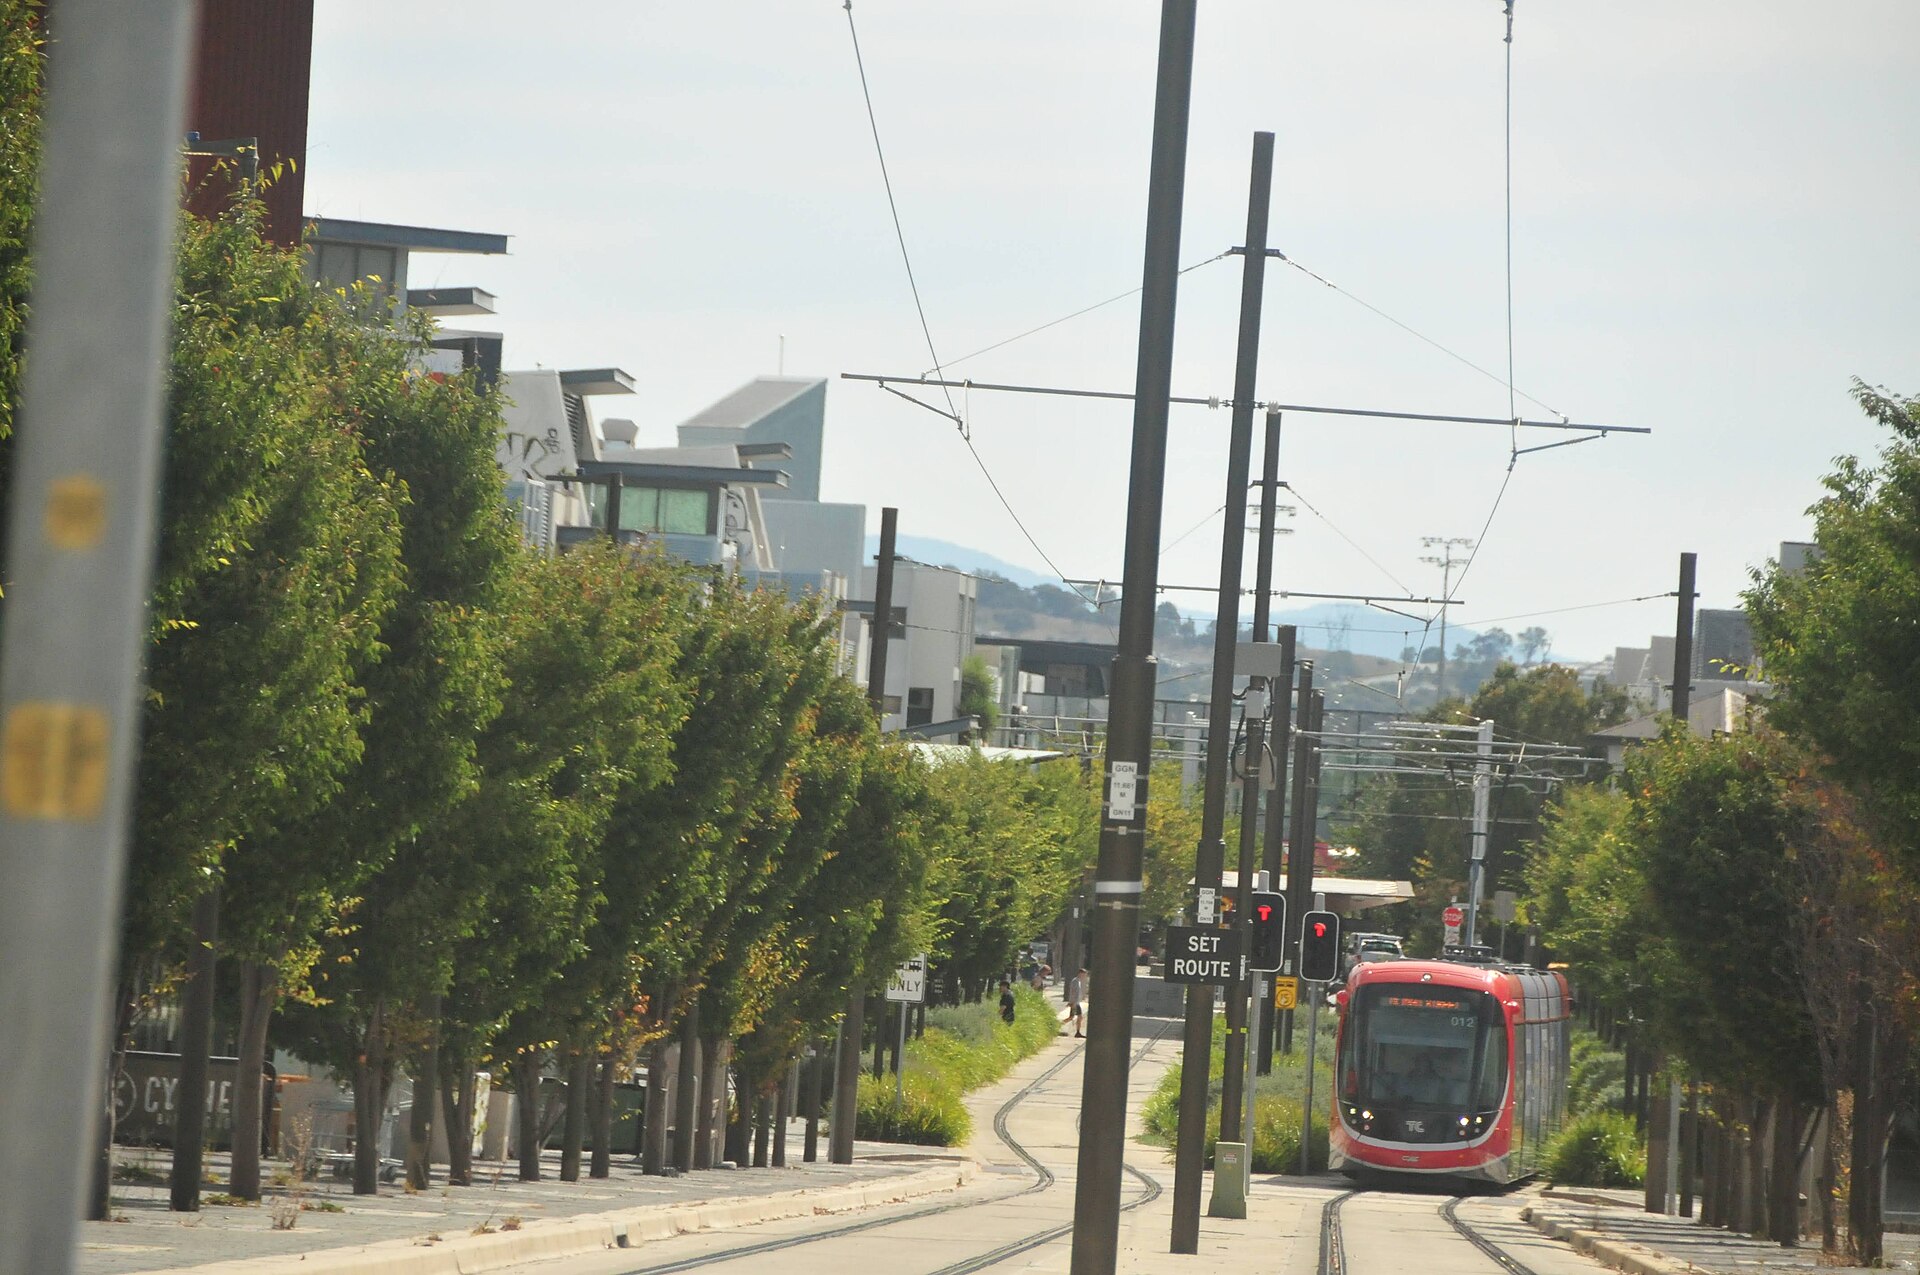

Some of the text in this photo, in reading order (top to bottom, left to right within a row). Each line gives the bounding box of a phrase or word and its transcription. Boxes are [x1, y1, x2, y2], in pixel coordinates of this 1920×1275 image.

[1115, 765, 1135, 773] GGN
[1444, 913, 1463, 922] STOP
[1188, 935, 1220, 953] SET
[1174, 958, 1231, 978] ROUTE
[1450, 1016, 1474, 1027] 012
[1405, 1120, 1425, 1133] TC
